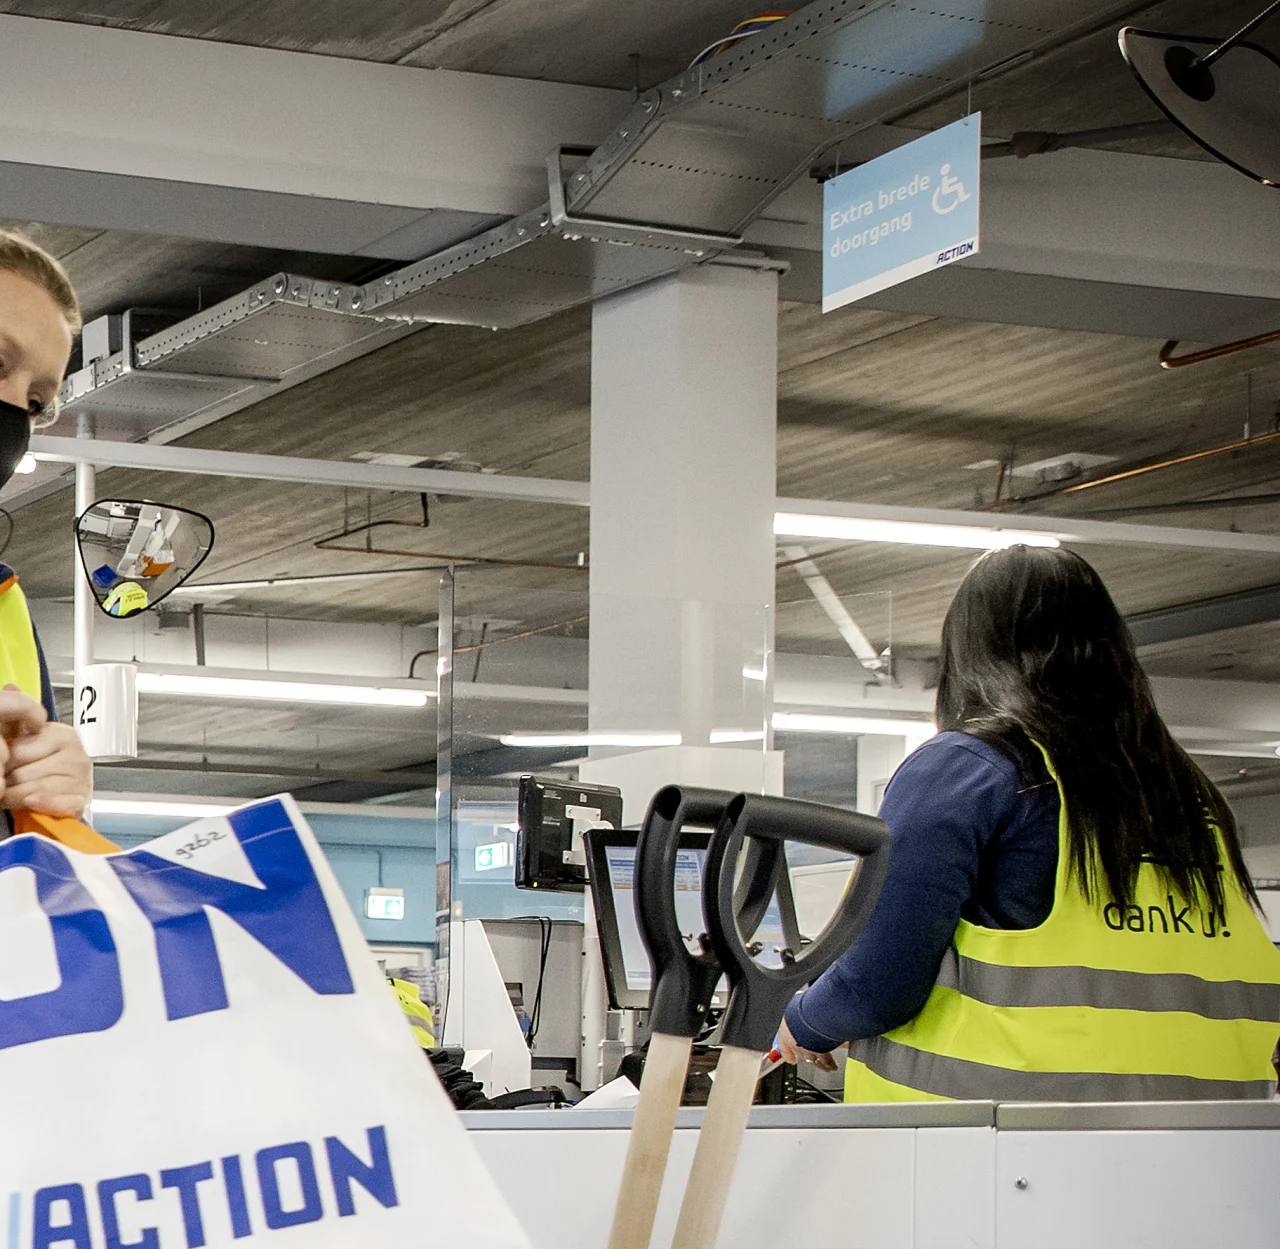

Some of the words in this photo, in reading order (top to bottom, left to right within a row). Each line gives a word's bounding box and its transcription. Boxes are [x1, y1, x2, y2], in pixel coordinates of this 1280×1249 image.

[830, 201, 873, 231] Extra
[878, 174, 931, 210] brede
[830, 211, 912, 258] doorgang
[936, 241, 975, 264] ACTION
[1103, 894, 1195, 934] dank
